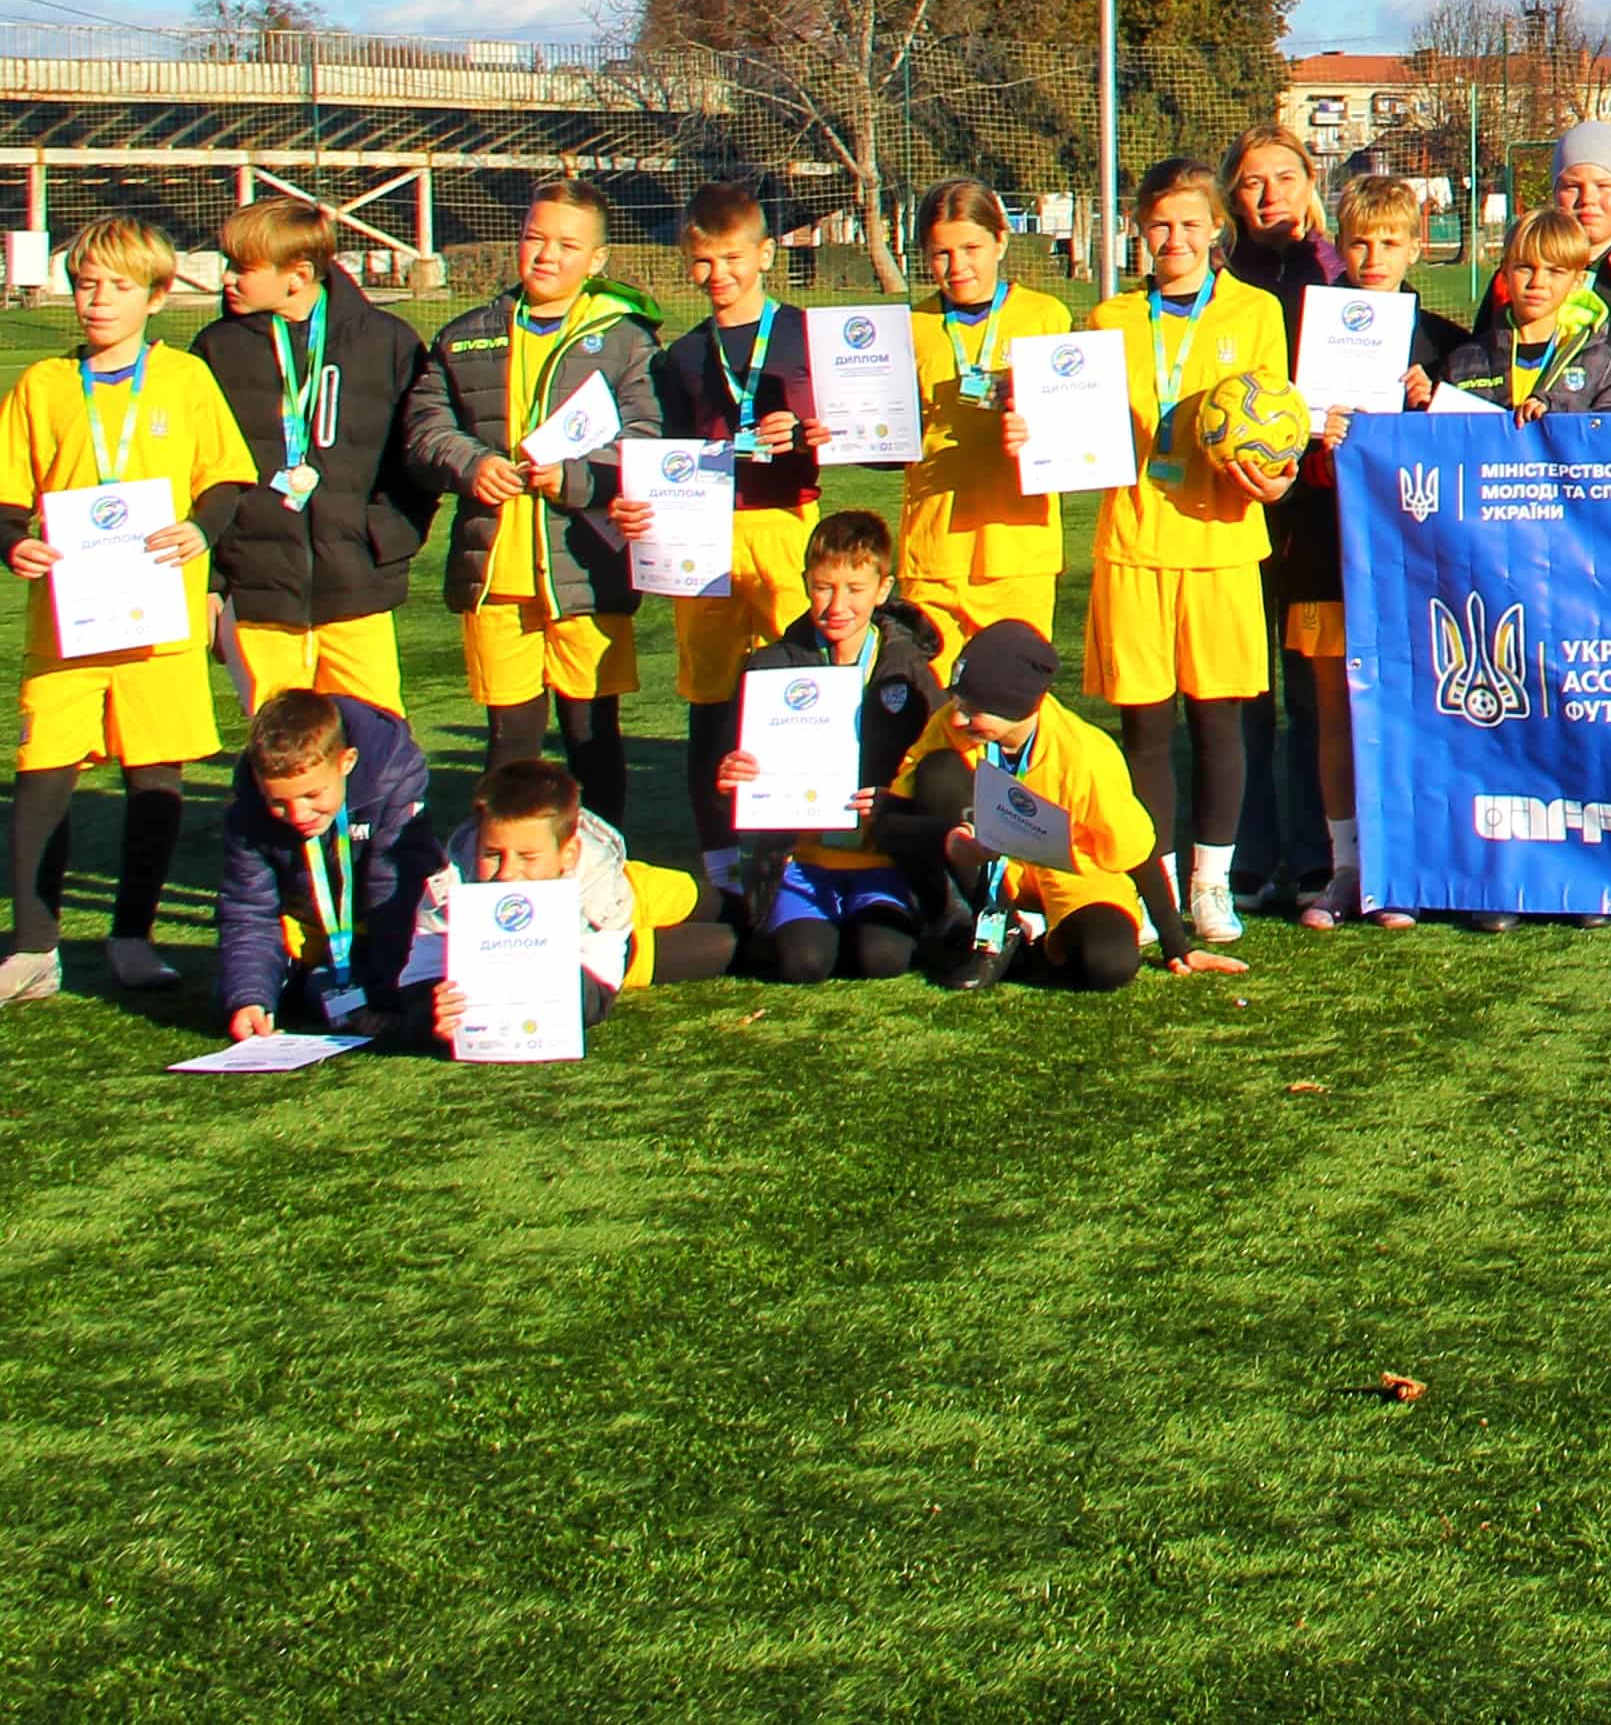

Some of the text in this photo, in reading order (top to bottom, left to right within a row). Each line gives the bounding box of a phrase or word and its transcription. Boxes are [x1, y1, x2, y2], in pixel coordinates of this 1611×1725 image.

[834, 353, 890, 366] ДИПЛОМ
[1480, 482, 1559, 500] МОЛОДІ
[1563, 484, 1586, 499] ТА
[1480, 501, 1565, 522] УКРАЇНИ
